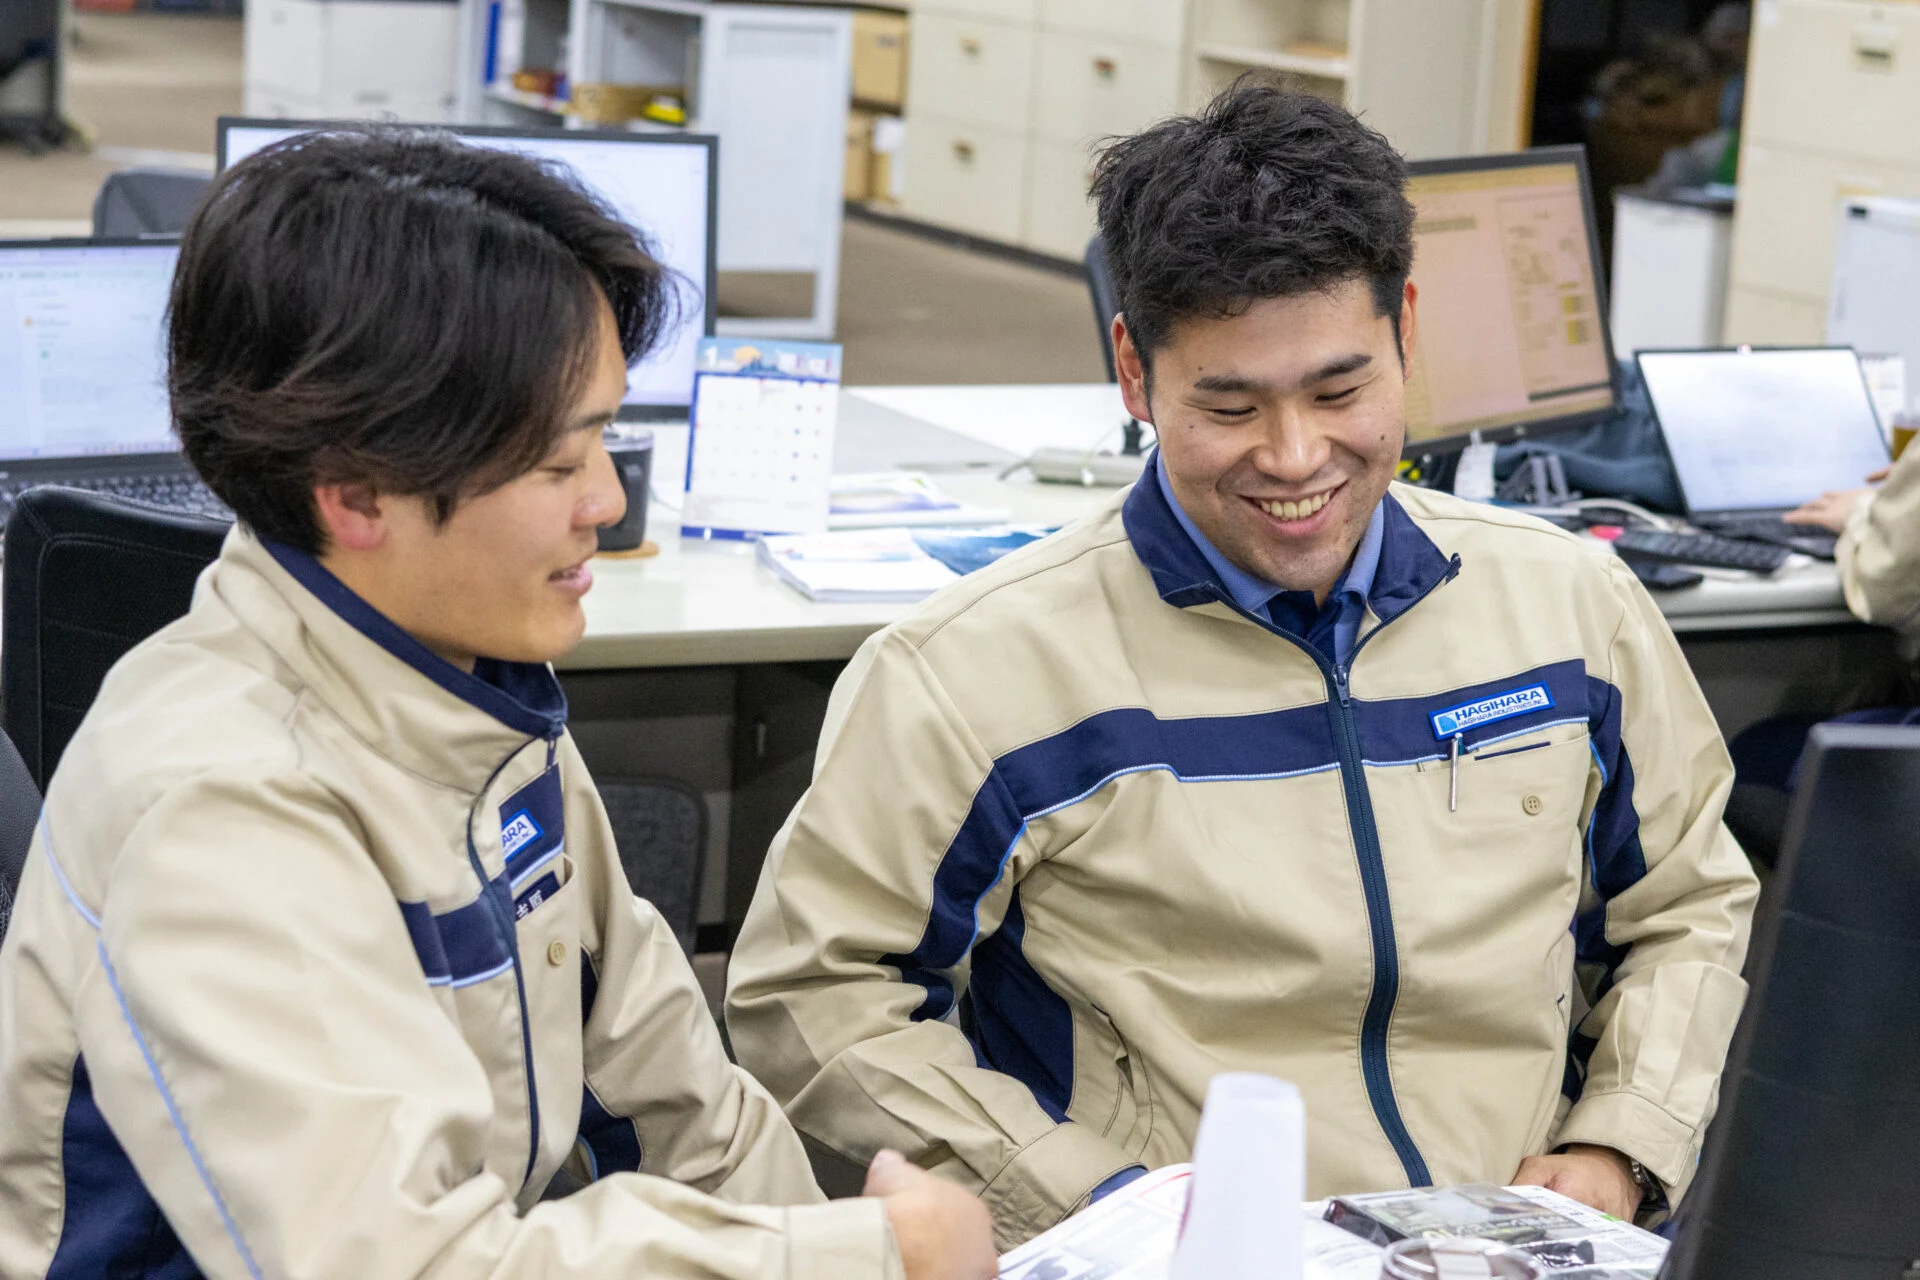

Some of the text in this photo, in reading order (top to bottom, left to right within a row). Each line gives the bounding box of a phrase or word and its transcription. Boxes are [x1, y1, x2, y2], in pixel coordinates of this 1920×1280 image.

[1455, 690, 1542, 721] HAGIHARA
[1458, 713, 1492, 727] HAGIHARA
[1493, 702, 1532, 718] INDUSTRIES
